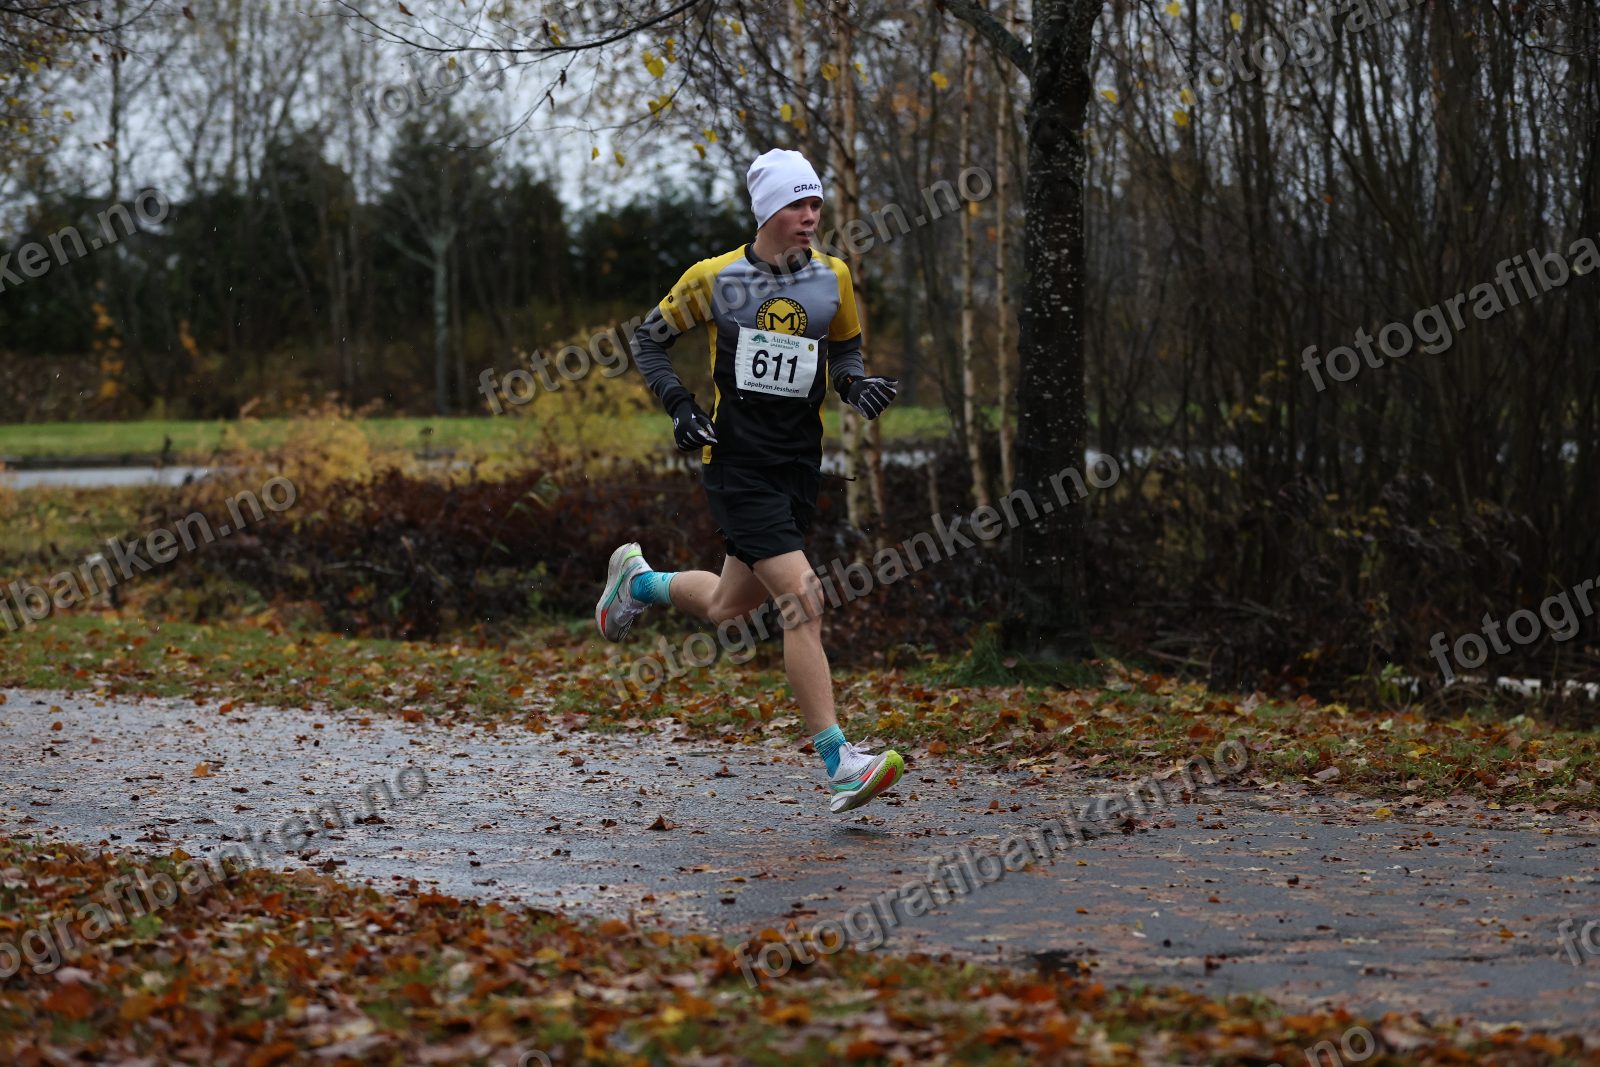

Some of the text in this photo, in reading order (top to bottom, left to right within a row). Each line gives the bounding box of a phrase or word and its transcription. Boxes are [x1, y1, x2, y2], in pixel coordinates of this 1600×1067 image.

[771, 335, 800, 349] Aurskog
[752, 349, 798, 384] 611
[773, 385, 800, 394] Jessheim
